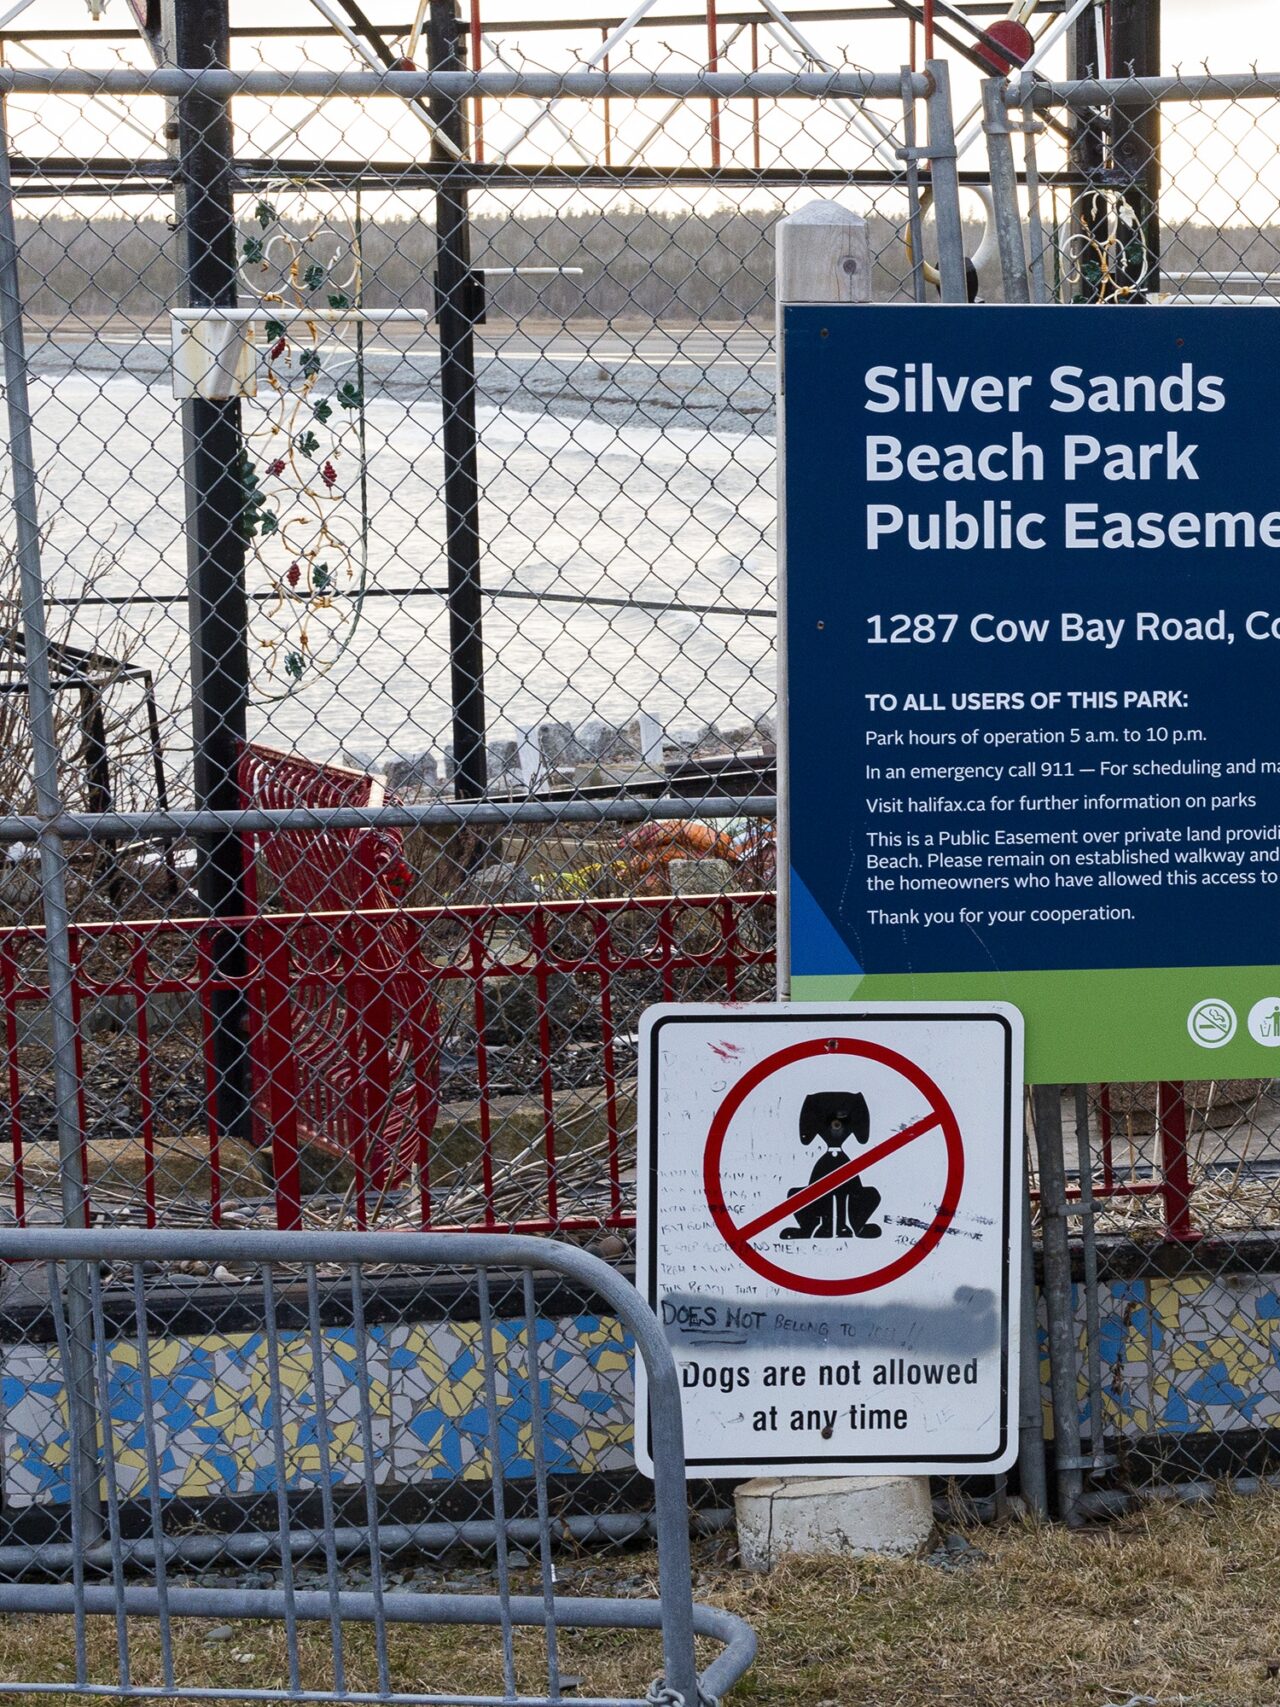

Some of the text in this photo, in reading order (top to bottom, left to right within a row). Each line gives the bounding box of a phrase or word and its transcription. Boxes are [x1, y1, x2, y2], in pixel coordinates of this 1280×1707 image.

[864, 362, 1226, 413] Silver Sands
[866, 430, 1200, 482] Beach Park
[866, 500, 1047, 551] Public
[866, 613, 959, 644] 1287
[970, 613, 1050, 643] Cow
[1061, 612, 1126, 649] Bay
[1136, 609, 1235, 645] Road,
[864, 690, 1189, 712] TO ALL USERS OF THIS PARK:
[865, 726, 1207, 748] Park hours of operation 5 a.m. to 10 p.m.
[866, 764, 881, 780] In
[885, 767, 906, 780] an
[910, 766, 1004, 782] emergency
[1008, 761, 1036, 778] call
[1040, 762, 1075, 777] 911
[1100, 761, 1129, 776] For
[1132, 759, 1222, 778] scheduling
[1225, 758, 1256, 774] and
[865, 791, 1257, 813] Visit halifax.ca for further information on parks
[866, 831, 902, 847] This
[907, 834, 920, 847] is
[924, 834, 935, 847] a
[939, 829, 990, 846] Public
[995, 829, 1078, 845] Easement
[1082, 831, 1120, 844] over
[1124, 827, 1182, 846] private
[1186, 825, 1221, 842] land
[867, 852, 923, 869] Beach.
[927, 852, 983, 868] Please
[987, 854, 1045, 867] remain
[1049, 854, 1071, 866] on
[1075, 848, 1170, 866] established
[1174, 847, 1246, 866] walkway
[1249, 846, 1280, 862] and
[866, 875, 895, 891] the
[899, 874, 1010, 891] homeowners
[1013, 872, 1050, 888] who
[1055, 872, 1094, 888] have
[1098, 870, 1162, 887] allowed
[1166, 869, 1198, 886] this
[1201, 872, 1256, 885] access
[1260, 869, 1278, 884] to
[866, 906, 1135, 928] Thank you for your cooperation.
[661, 1300, 718, 1327] DOES
[725, 1307, 768, 1329] NOT
[682, 1358, 978, 1394] Dogs are not allowed
[752, 1404, 908, 1436] at any time
